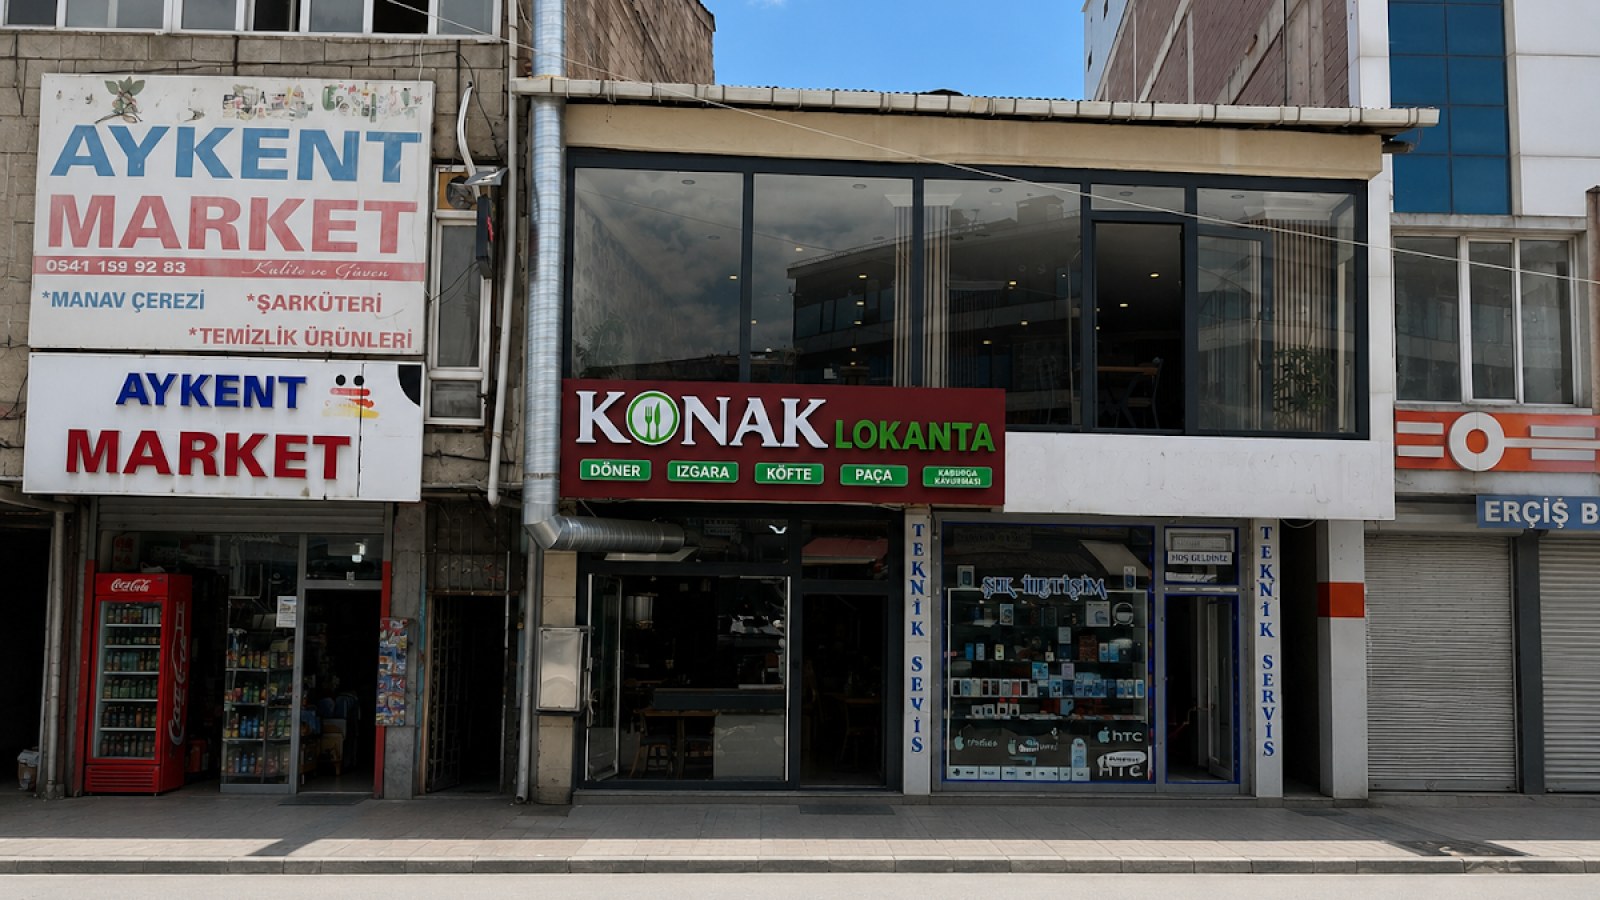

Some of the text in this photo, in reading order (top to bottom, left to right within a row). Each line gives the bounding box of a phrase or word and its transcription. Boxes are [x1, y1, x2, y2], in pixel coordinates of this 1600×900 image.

[50, 124, 422, 183] AYKENT
[47, 194, 418, 254] MARKET
[46, 259, 187, 274] 0541 159 92 83
[131, 289, 205, 313] ÇEREZİ
[304, 325, 413, 349] ÜRÜNLERİ
[115, 372, 308, 410] AYKENT
[575, 389, 997, 452] KONAK LOKANTA
[66, 428, 352, 481] MARKET
[590, 461, 641, 477] DÖNER
[676, 465, 730, 479] IZGARA
[767, 464, 812, 481] KÖFTE
[855, 468, 893, 484] PAÇA
[1485, 497, 1569, 529] ERÇİŞ
[910, 523, 926, 637] TEKNİK
[1260, 526, 1275, 757] TEKNİK SERVİS
